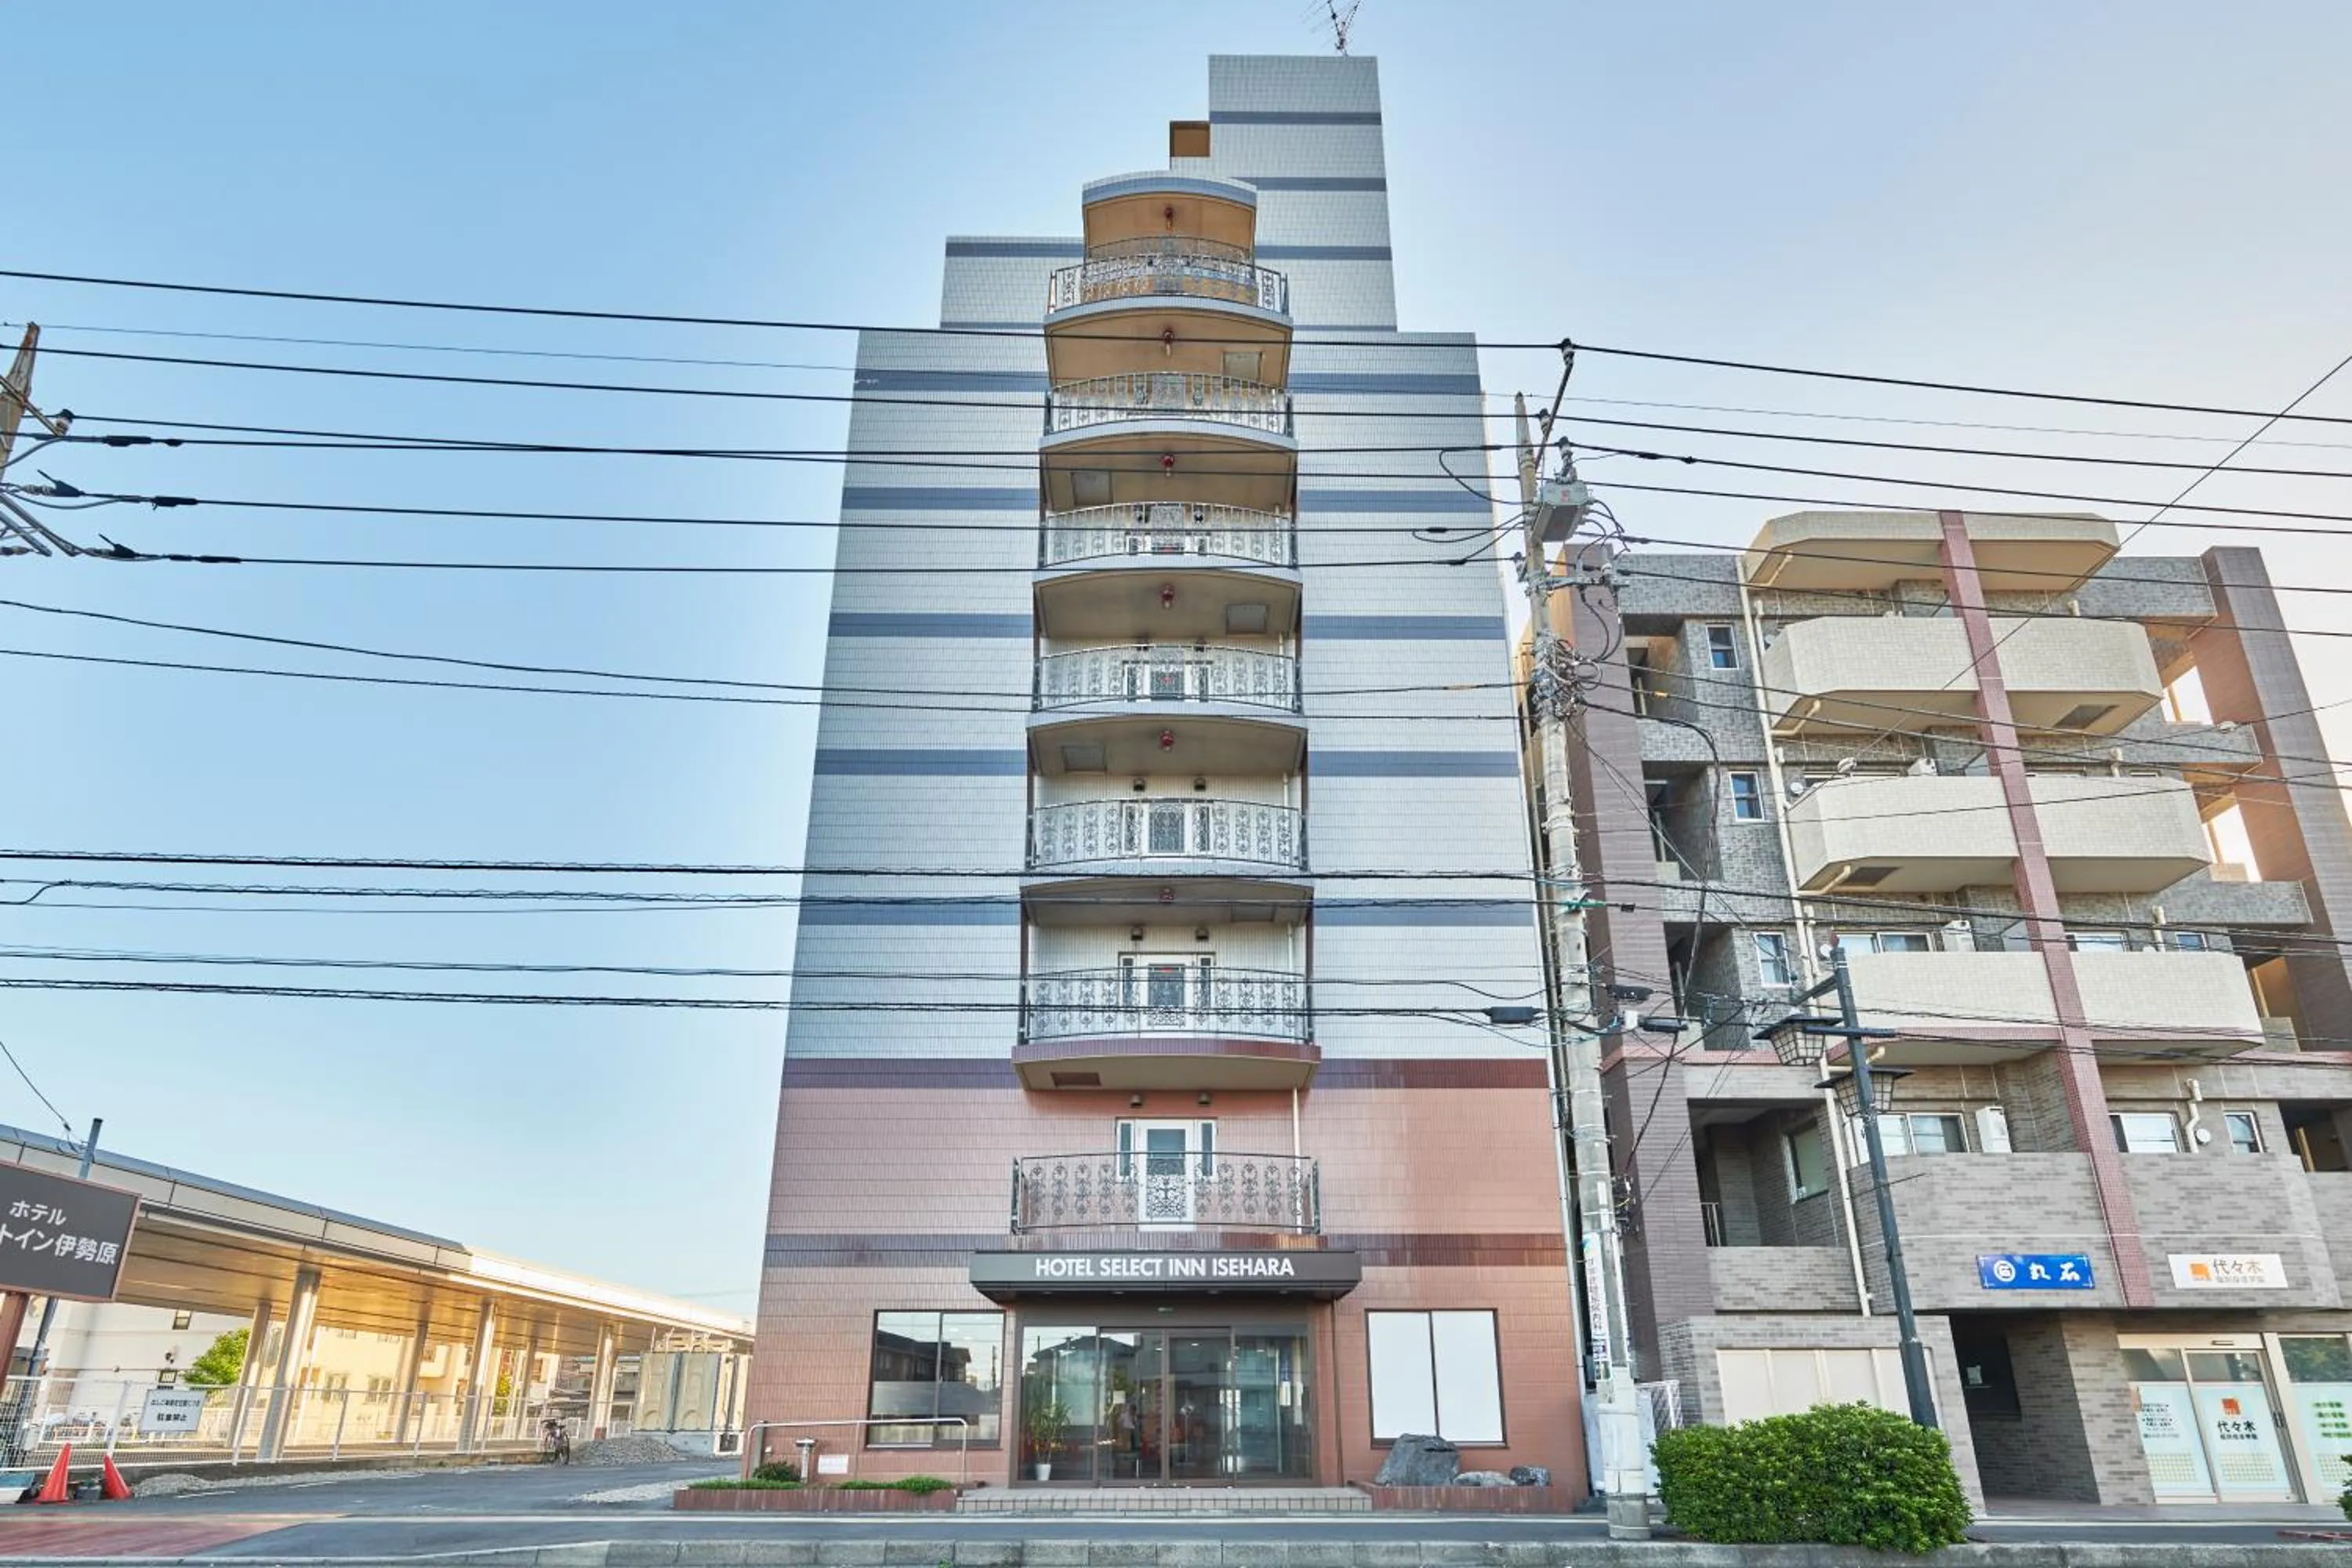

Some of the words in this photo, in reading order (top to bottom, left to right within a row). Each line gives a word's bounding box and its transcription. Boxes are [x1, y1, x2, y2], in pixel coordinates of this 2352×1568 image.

[9, 1200, 67, 1225] ホテル
[1036, 1258, 1094, 1277] HOTEL
[1099, 1258, 1163, 1277] SELECT
[1169, 1258, 1206, 1277] INN
[1212, 1258, 1294, 1277] ISEHARA
[2212, 1258, 2265, 1275] 代々木
[2217, 1420, 2256, 1432] 代々木
